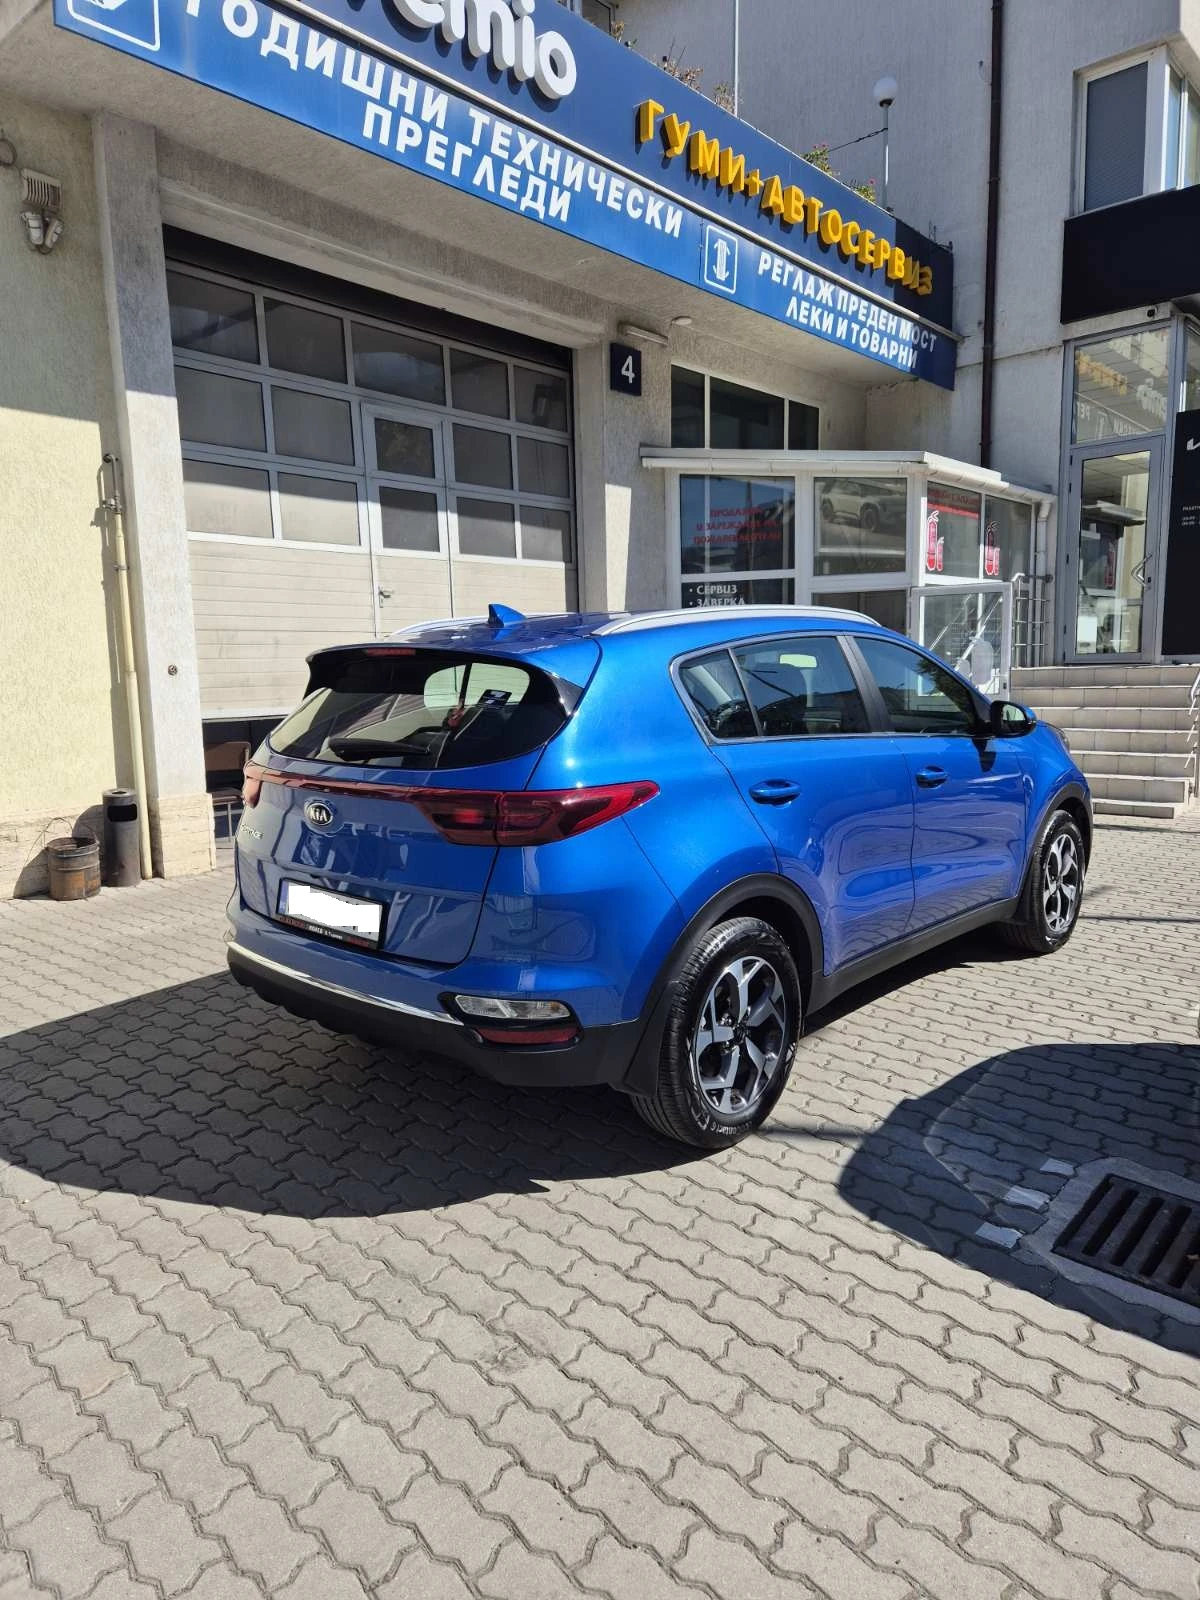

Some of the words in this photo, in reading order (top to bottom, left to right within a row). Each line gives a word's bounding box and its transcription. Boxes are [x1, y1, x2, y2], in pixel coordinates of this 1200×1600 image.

[186, 0, 449, 129] ОДИШНИ
[467, 107, 683, 239] ТЕХНИЧЕСКИ
[362, 101, 572, 223] ПРЕГЛЕДИ
[636, 98, 933, 296] ГУМИ+АВТОСЕРВИЗ
[757, 251, 835, 308] РЕГЛАЖ
[837, 287, 898, 335] ПРЕДЕН
[899, 319, 937, 353] МОСТ
[786, 296, 834, 337] ЛЕКИ
[836, 317, 849, 341] И
[850, 322, 917, 369] ТОВАРНИ
[621, 355, 635, 384] 4
[310, 805, 328, 822] KIA
